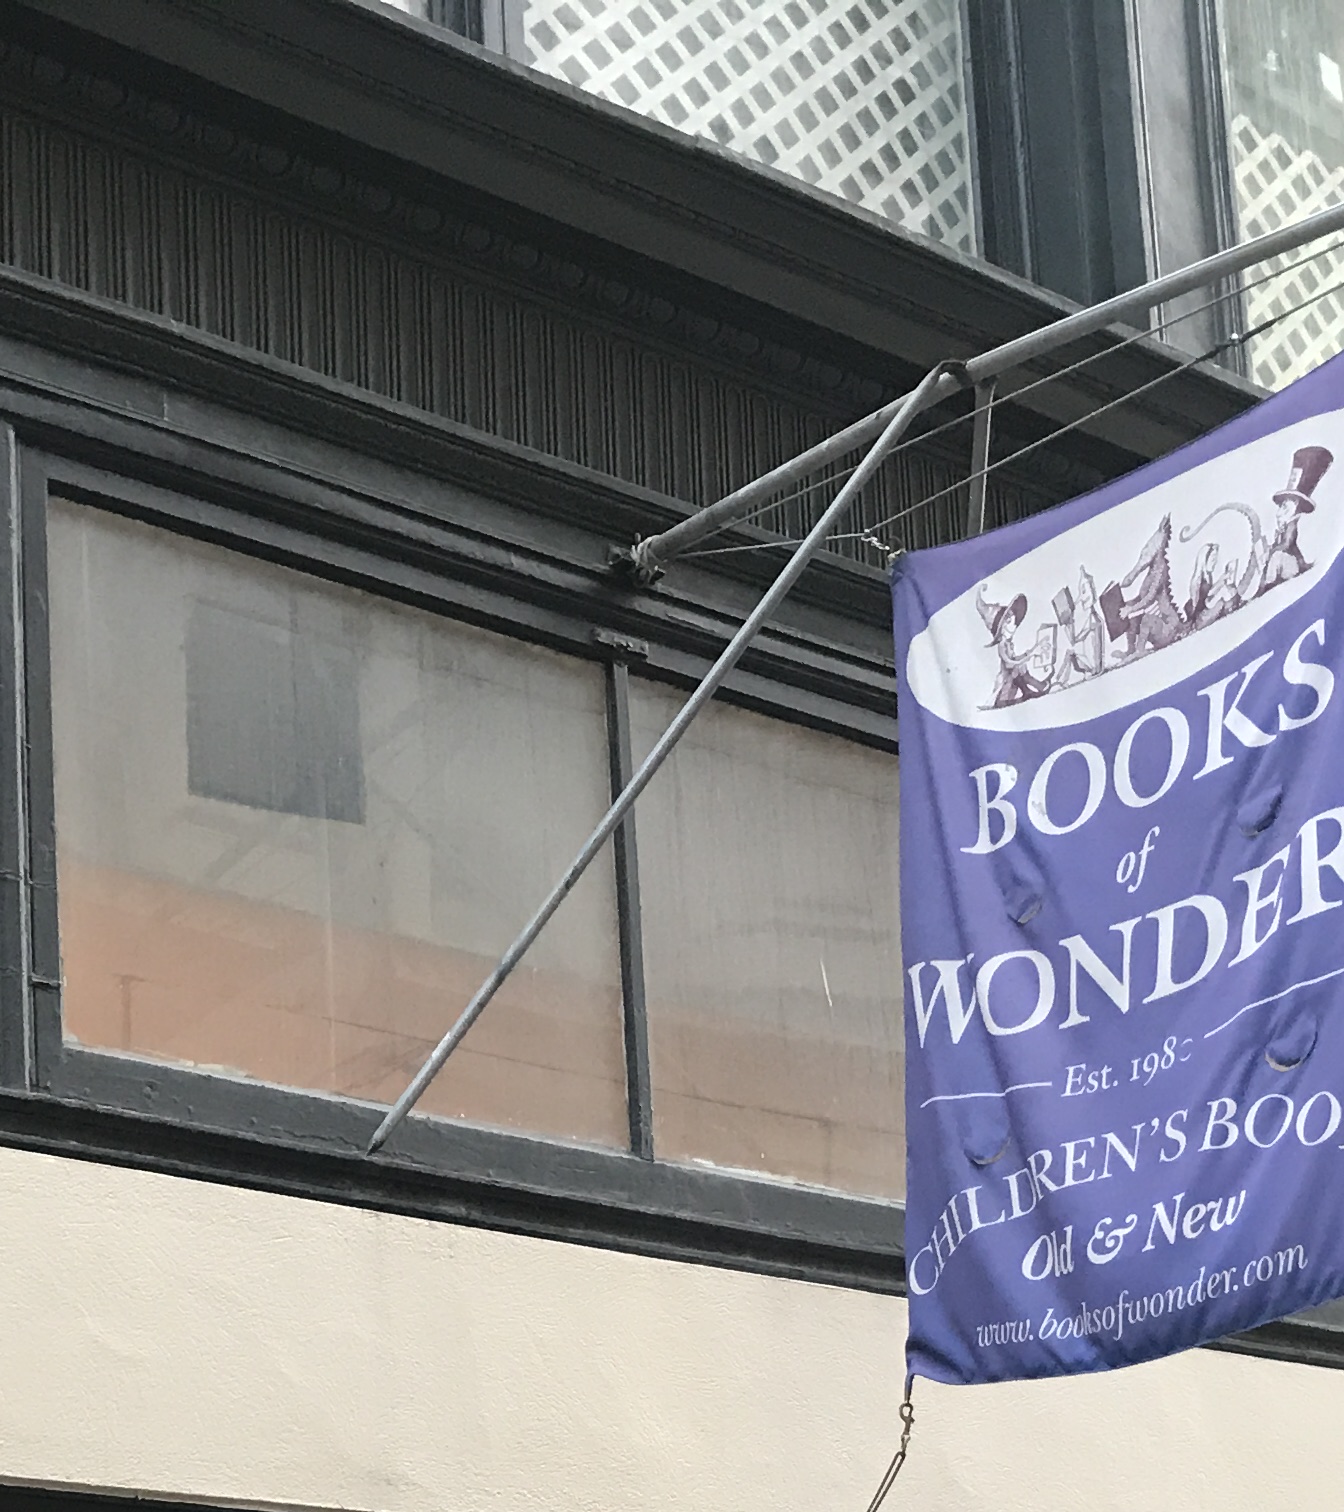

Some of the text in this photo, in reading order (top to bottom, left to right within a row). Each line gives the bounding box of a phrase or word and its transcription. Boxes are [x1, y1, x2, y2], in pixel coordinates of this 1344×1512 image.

[961, 619, 1335, 854] BOOKS
[1116, 827, 1160, 893] of
[1061, 1063, 1118, 1097] Est.
[1021, 1190, 1247, 1281] Old & New
[976, 1243, 1309, 1347] www.booksofwonder.com
